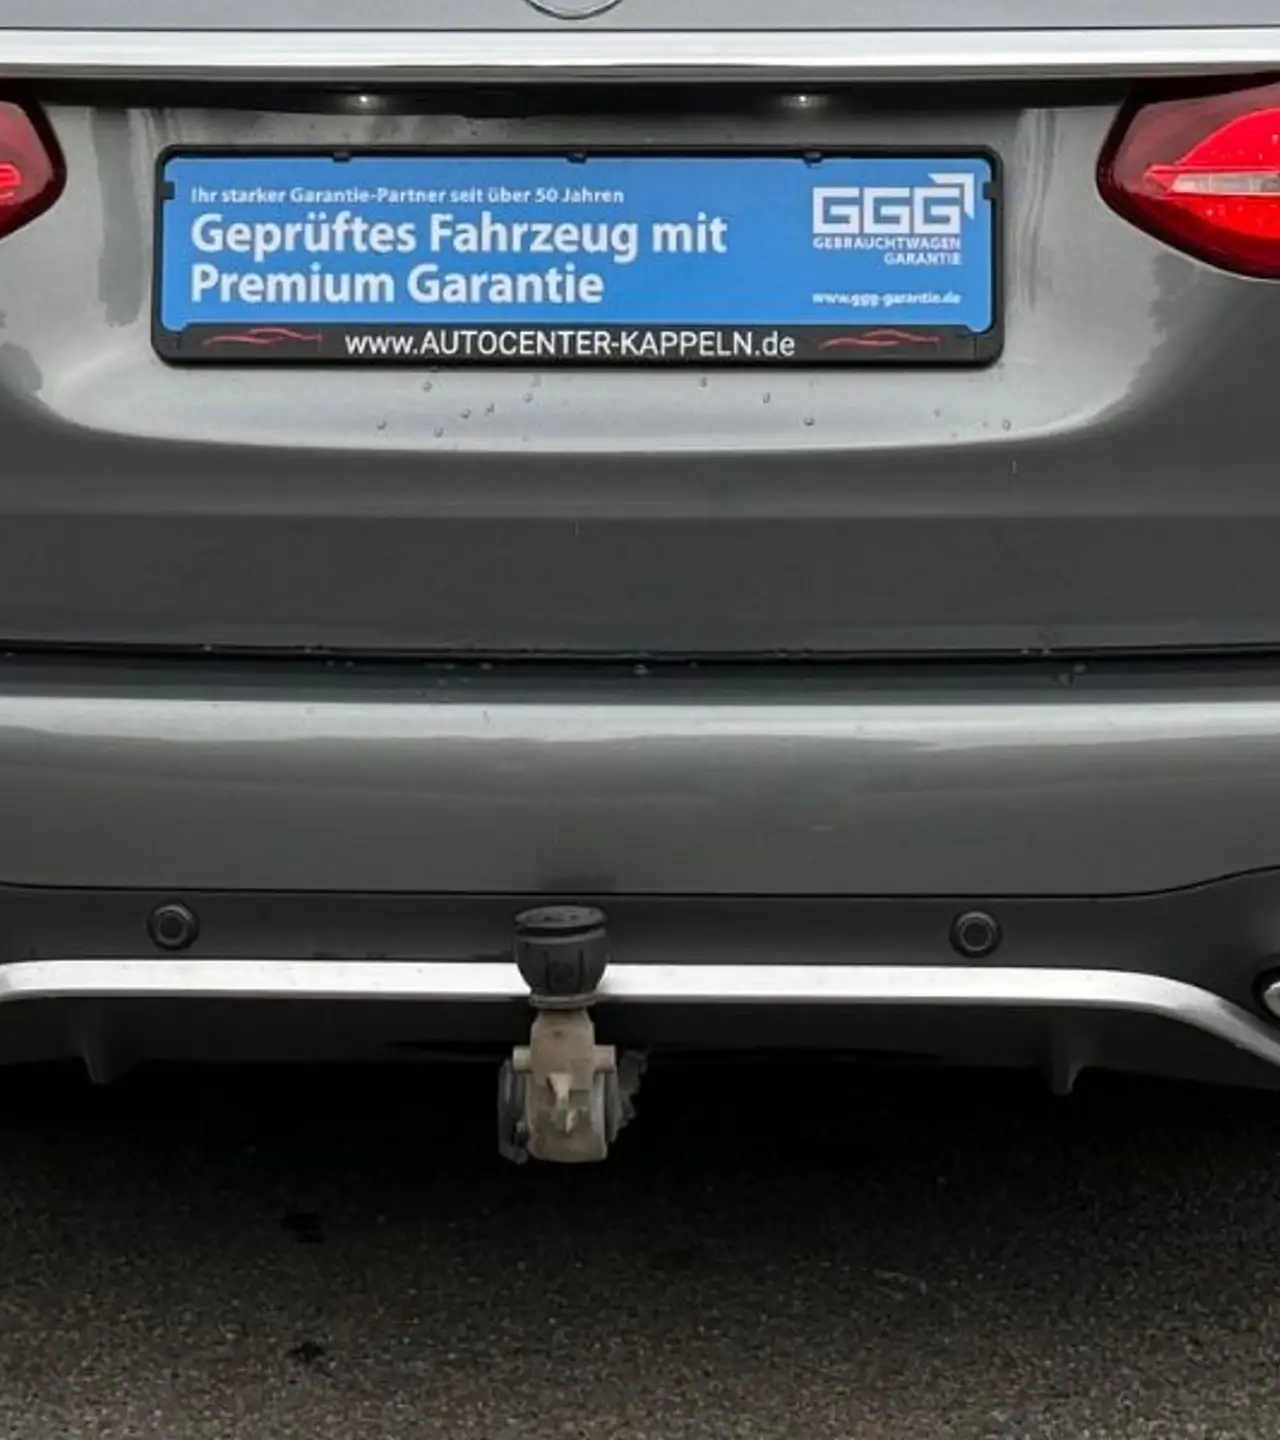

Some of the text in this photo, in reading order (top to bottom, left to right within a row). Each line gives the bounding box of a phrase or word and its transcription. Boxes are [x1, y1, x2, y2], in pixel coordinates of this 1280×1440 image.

[190, 186, 625, 205] Ihr starker Garantie-Partner seit über 50 Jahren
[812, 186, 962, 235] GGG
[189, 210, 728, 263] Geprüftes Fahrzeug mit
[812, 235, 962, 251] GEBRAUCHTWAGEN
[883, 252, 963, 267] GARANTIE
[190, 261, 605, 305] Premium Garantie
[344, 329, 796, 358] www.AUTOCENTER-KAPPELN.de
